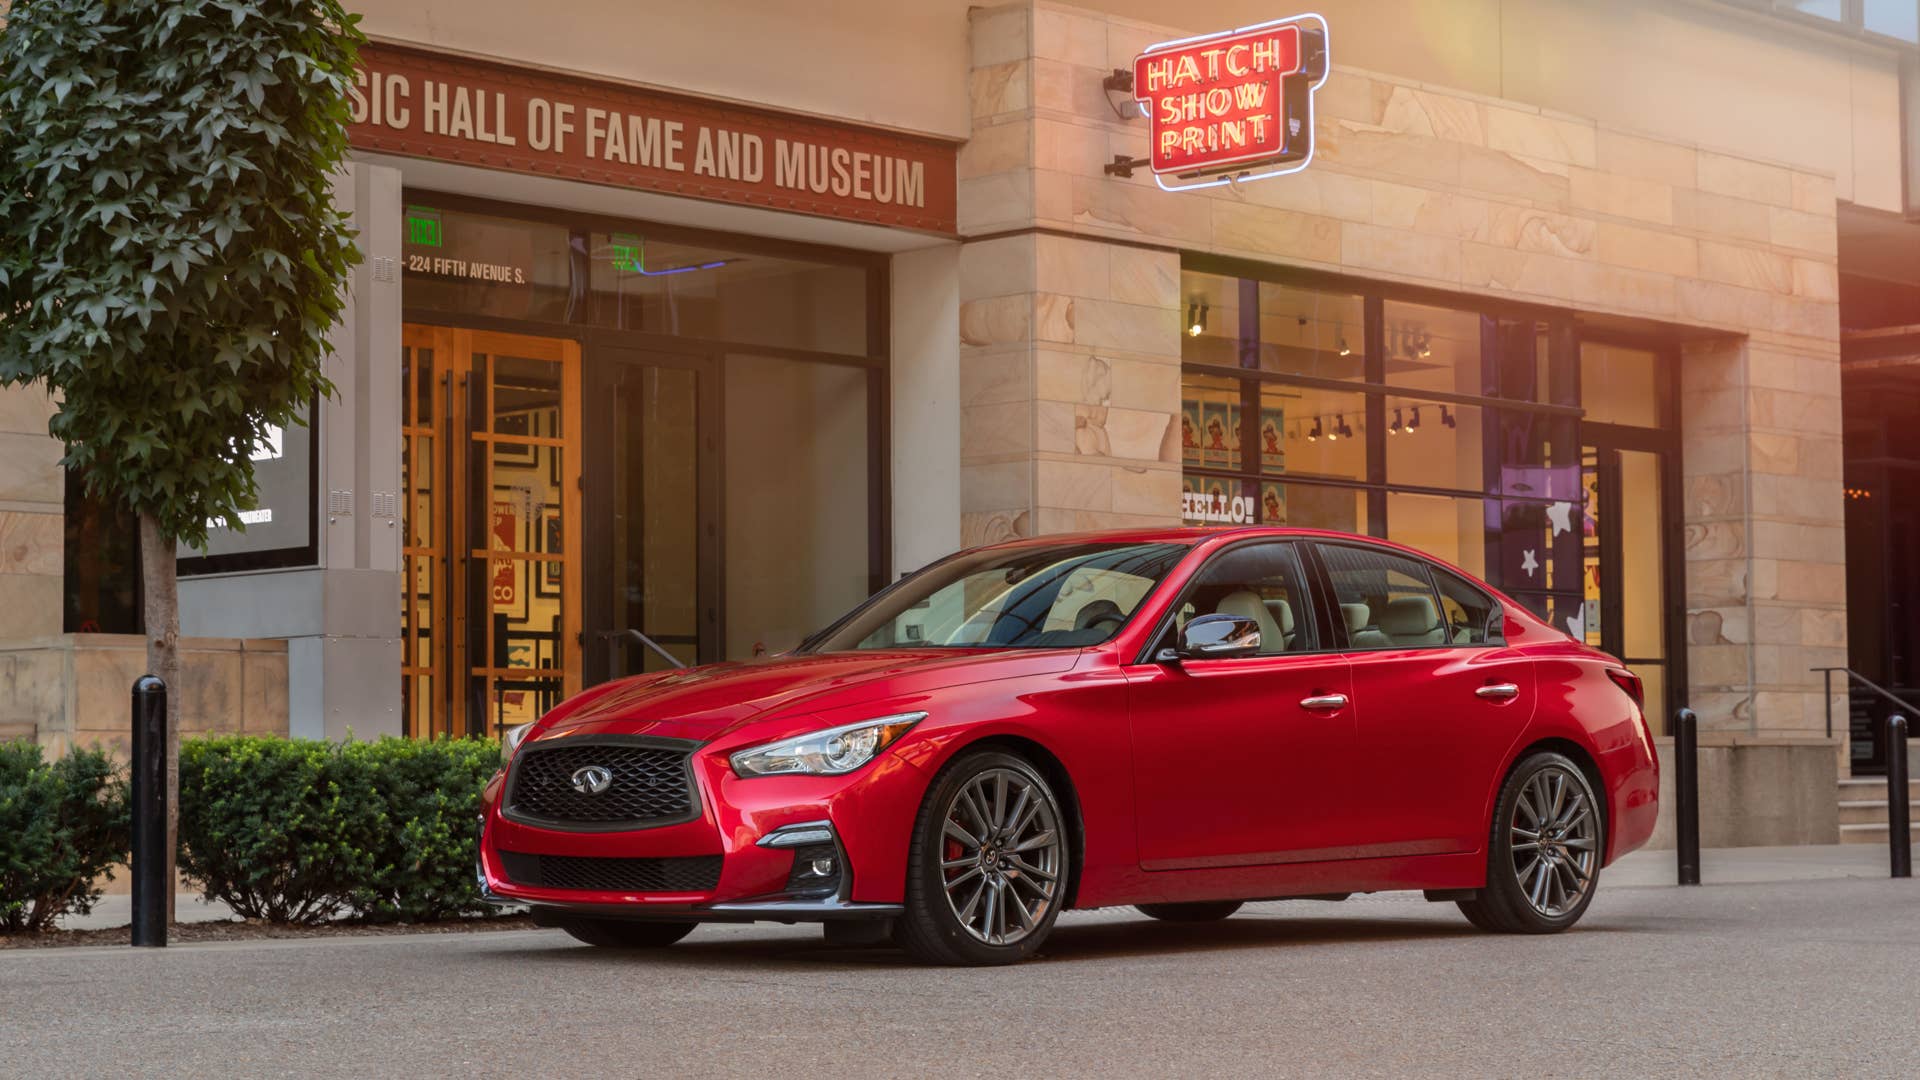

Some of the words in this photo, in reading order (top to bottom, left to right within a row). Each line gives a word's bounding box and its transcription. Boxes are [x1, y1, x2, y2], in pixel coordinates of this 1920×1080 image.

[1147, 38, 1280, 92] HATCH
[1160, 80, 1269, 124] SHOW
[424, 80, 516, 146] HALL
[528, 98, 575, 153] OF
[586, 107, 685, 172] FAME
[694, 126, 764, 184] AND
[775, 139, 925, 208] MUSEUM
[1160, 114, 1272, 160] PRINT
[409, 254, 431, 273] 224
[434, 257, 466, 277] FIFTH
[470, 262, 512, 282] AVENUE
[514, 267, 525, 284] S.
[1183, 491, 1255, 524] HELLO!
